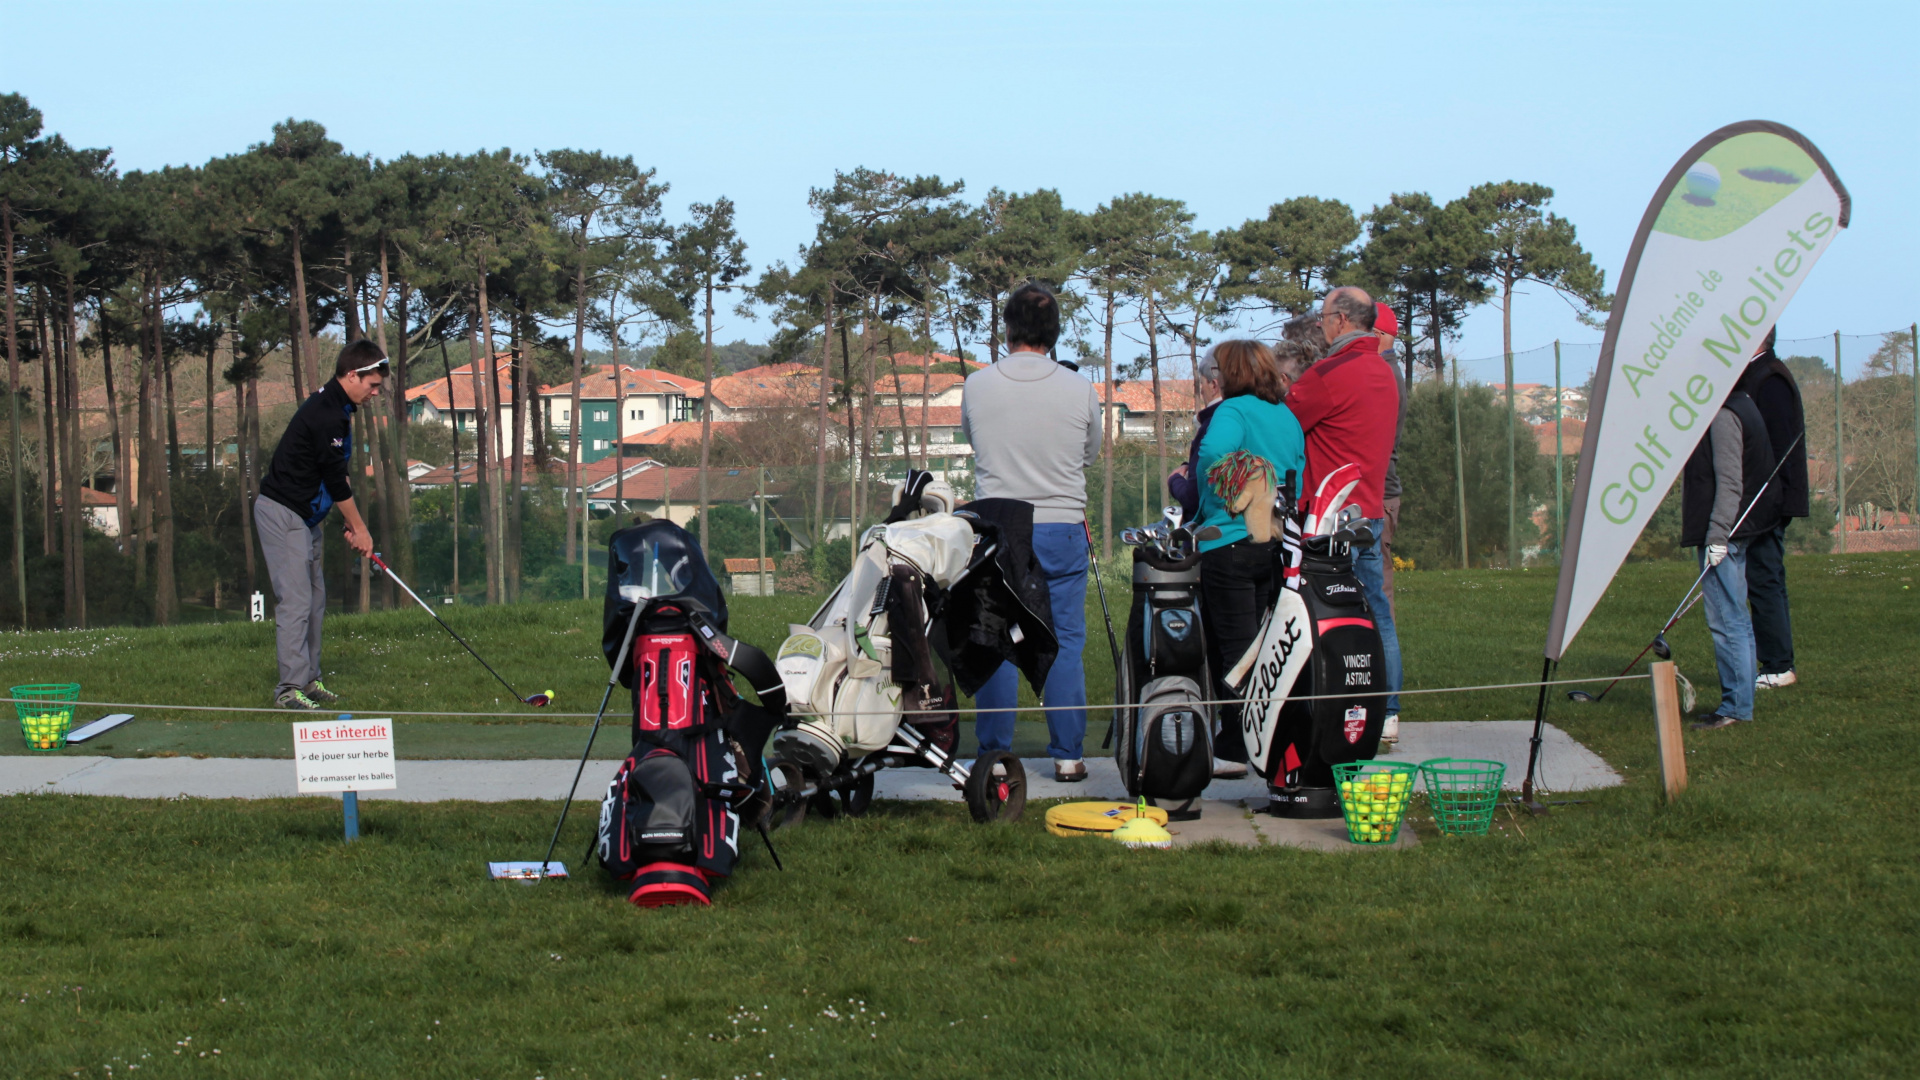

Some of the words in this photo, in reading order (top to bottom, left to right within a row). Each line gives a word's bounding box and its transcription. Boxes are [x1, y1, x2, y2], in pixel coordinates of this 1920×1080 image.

[1621, 284, 1706, 398] Académie
[1701, 267, 1724, 297] de
[1600, 424, 1673, 527] Golf
[1669, 373, 1715, 433] de
[1701, 209, 1835, 370] Moliets
[1326, 583, 1358, 596] Titleist
[1343, 654, 1372, 668] VINCENT
[1345, 671, 1372, 686] ASTRUC
[1244, 615, 1302, 758] Titleist
[299, 727, 308, 740] Il
[311, 728, 332, 740] est
[336, 725, 387, 738] interdit
[308, 752, 320, 761] de
[321, 752, 345, 762] jouer
[347, 752, 361, 760] sur
[363, 750, 389, 759] herbe
[308, 775, 319, 783] de
[320, 774, 356, 782] ramasser
[358, 773, 369, 781] les
[371, 772, 394, 781] balles
